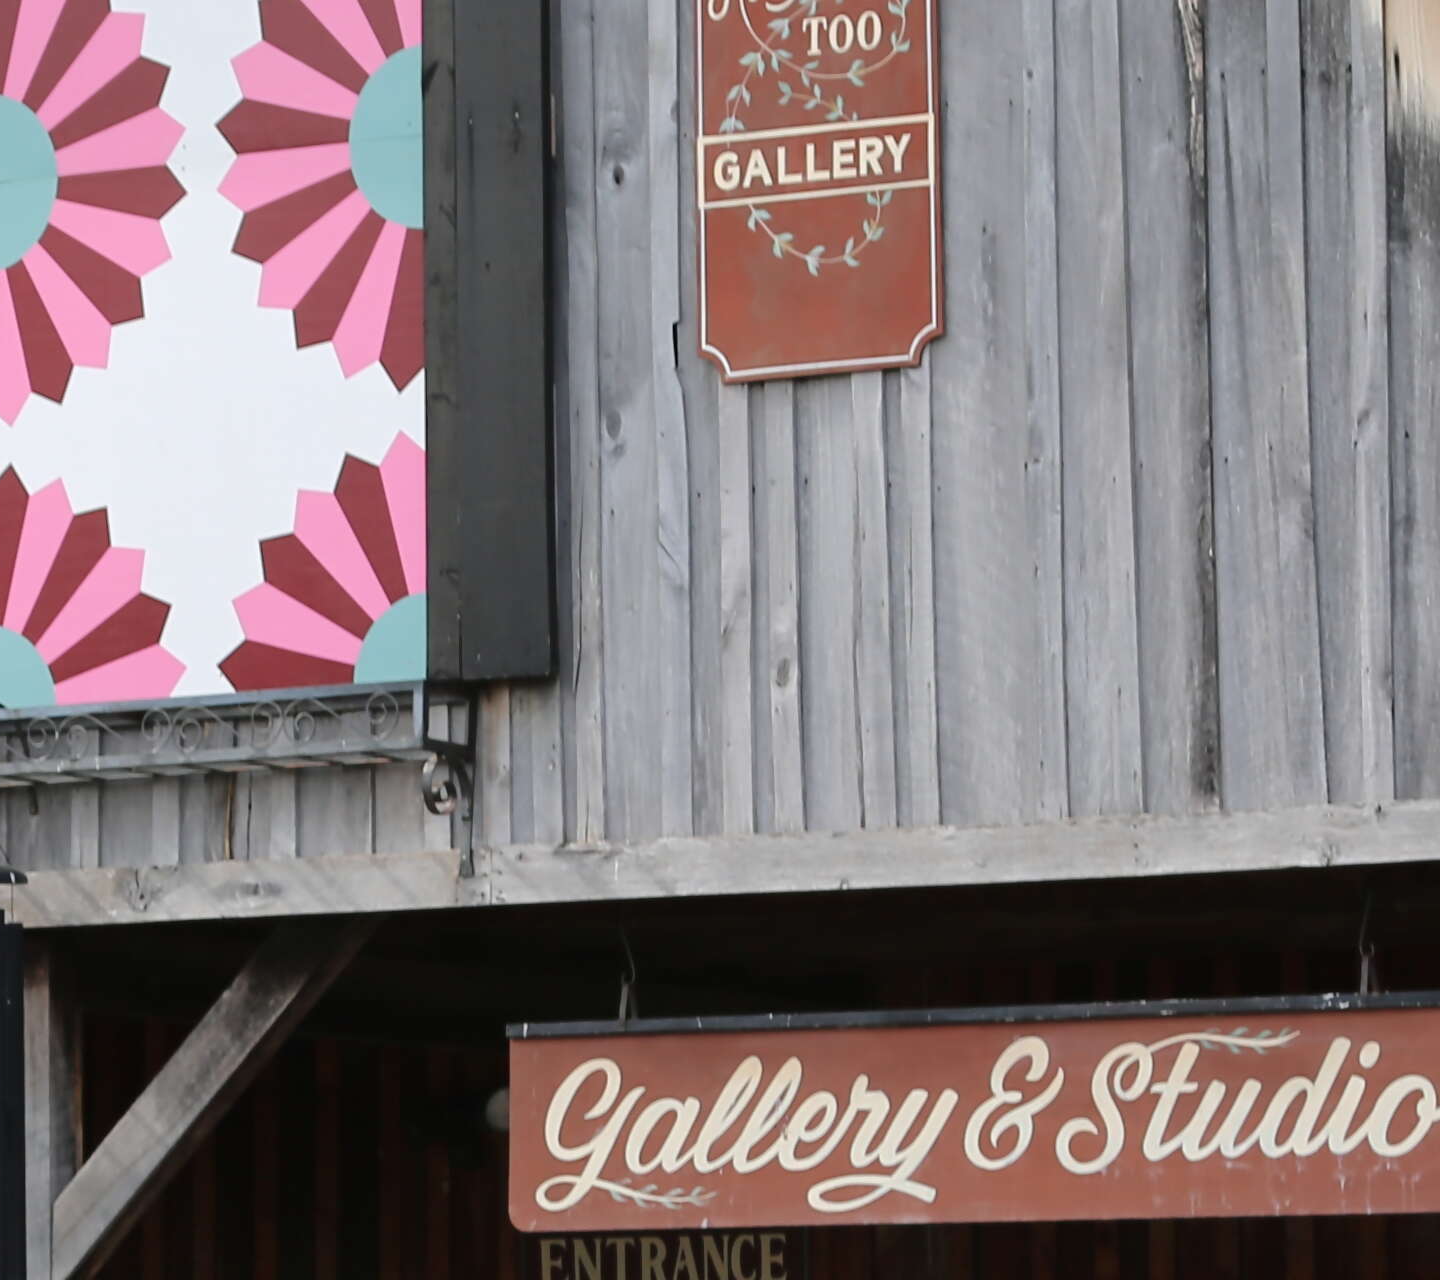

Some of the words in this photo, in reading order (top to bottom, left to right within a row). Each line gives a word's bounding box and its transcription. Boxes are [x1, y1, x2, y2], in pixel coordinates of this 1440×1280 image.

[802, 10, 883, 58] TOO
[712, 133, 912, 192] GALLERY
[534, 1052, 961, 1214] Gallery
[962, 1035, 1065, 1173] &
